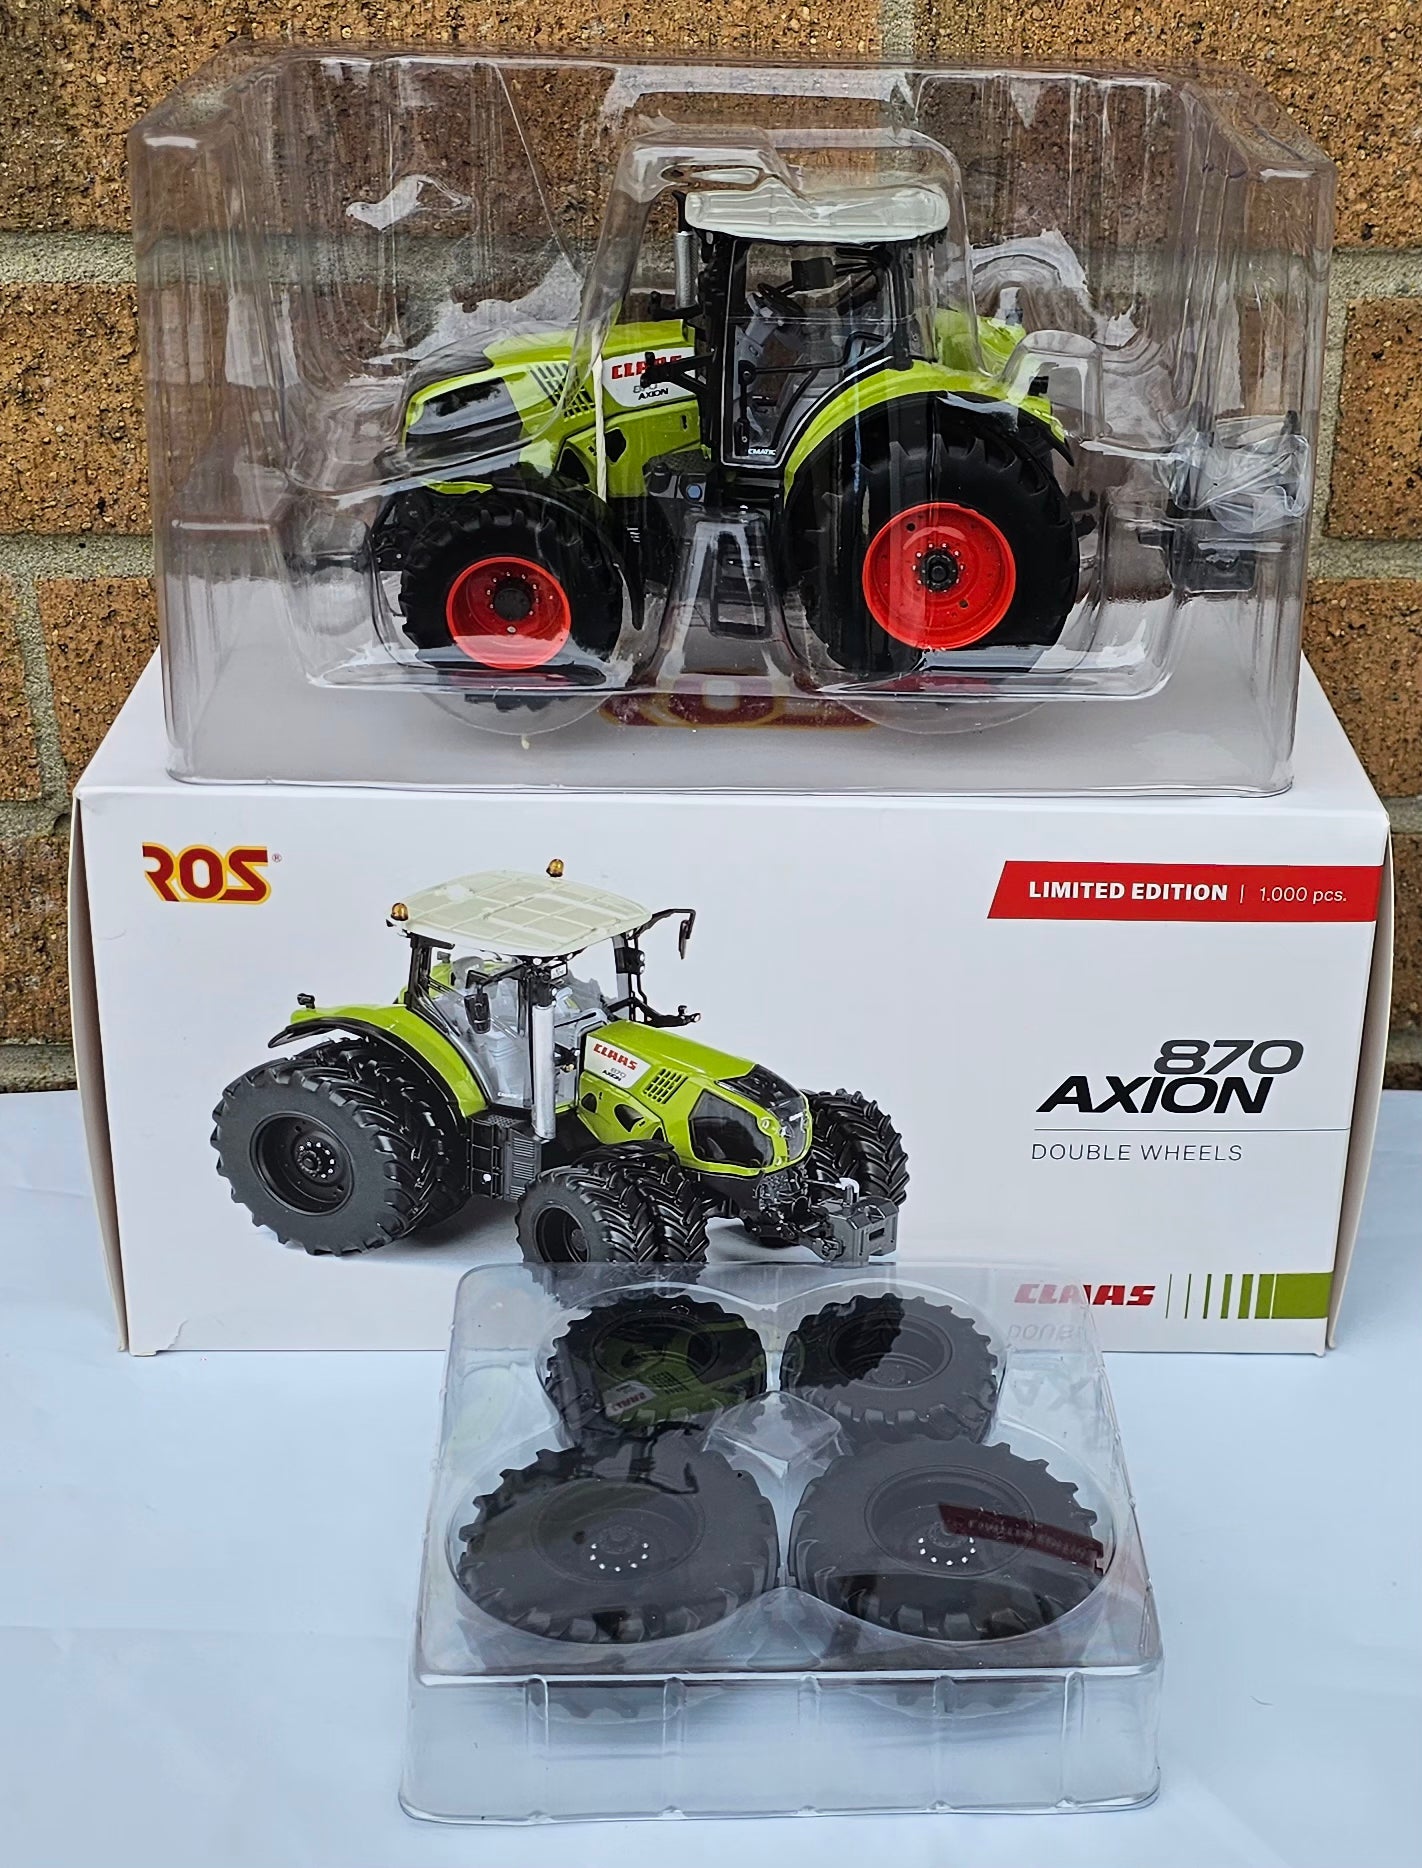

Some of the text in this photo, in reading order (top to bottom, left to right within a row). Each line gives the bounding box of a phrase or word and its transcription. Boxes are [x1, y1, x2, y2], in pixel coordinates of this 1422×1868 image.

[611, 355, 682, 380] CLA
[638, 387, 669, 400] AXION
[747, 448, 777, 456] CMATIC
[1028, 881, 1348, 905] LIMITED EDITION 1.000 pcs.
[593, 1042, 639, 1071] CLAAS
[1153, 1039, 1305, 1075] 870
[1036, 1075, 1275, 1114] AXION
[1031, 1143, 1243, 1162] DOUBLE WHEELS
[1013, 1283, 1157, 1307] CLAAS
